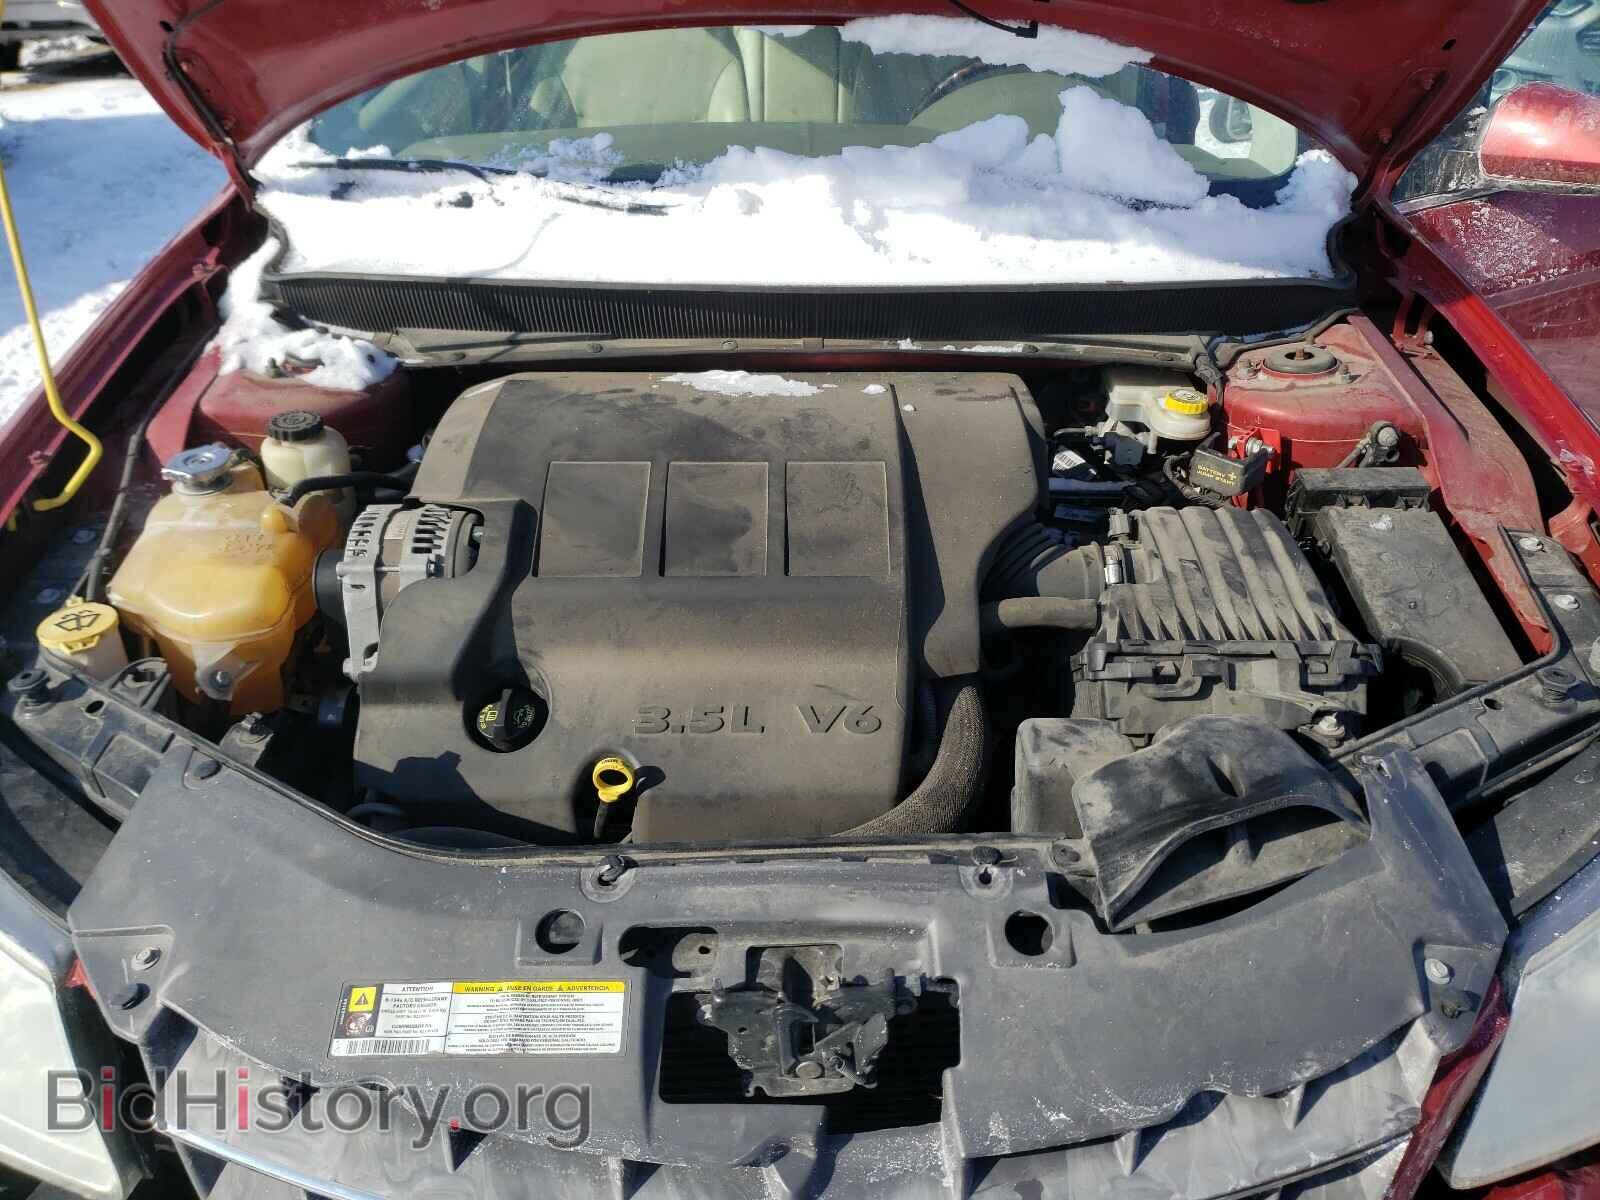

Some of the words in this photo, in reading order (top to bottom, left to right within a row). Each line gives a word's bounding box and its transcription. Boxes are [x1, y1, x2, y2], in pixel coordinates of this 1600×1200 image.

[1196, 464, 1226, 477] BATTERY
[633, 704, 765, 736] 3.5L
[798, 704, 883, 735] V6
